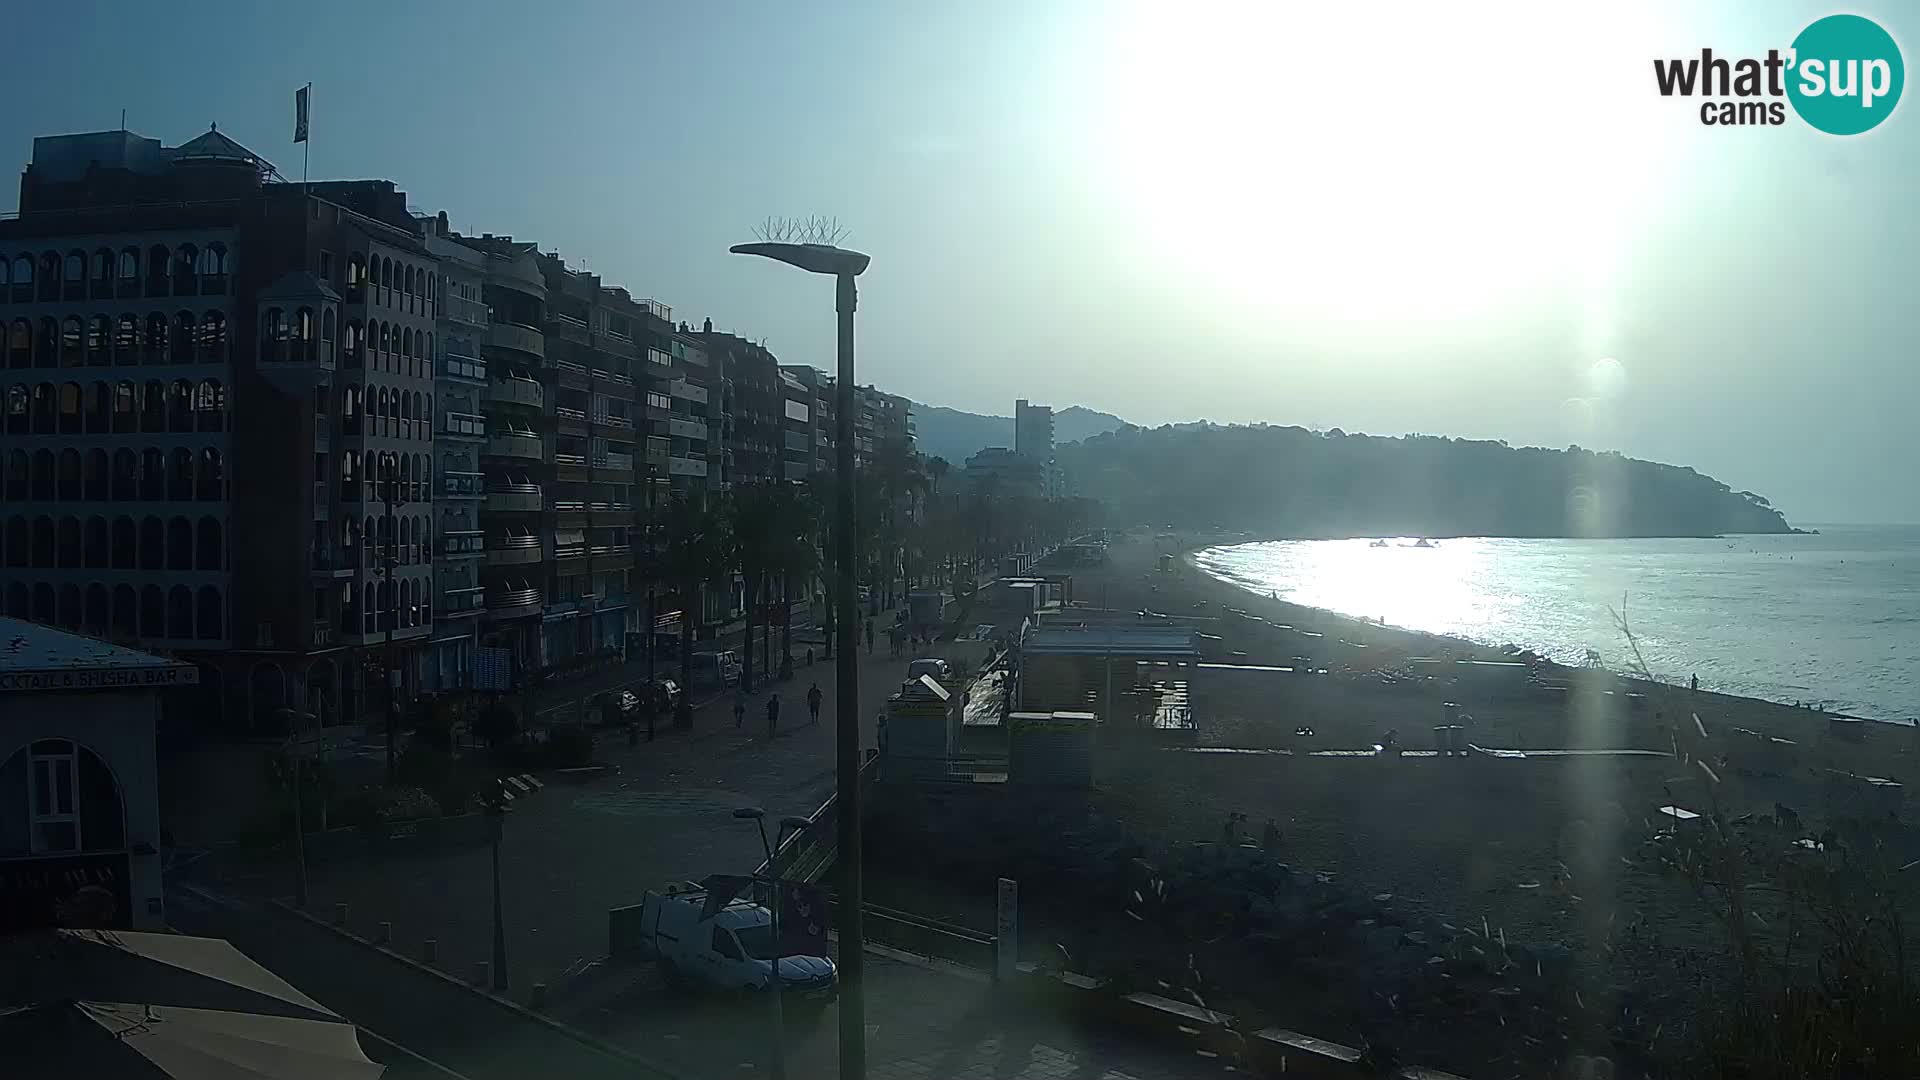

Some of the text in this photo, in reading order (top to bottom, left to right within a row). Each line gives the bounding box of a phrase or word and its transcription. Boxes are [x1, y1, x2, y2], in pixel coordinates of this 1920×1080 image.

[63, 672, 73, 687] &
[79, 670, 138, 687] SHISHA
[144, 669, 177, 684] BAR
